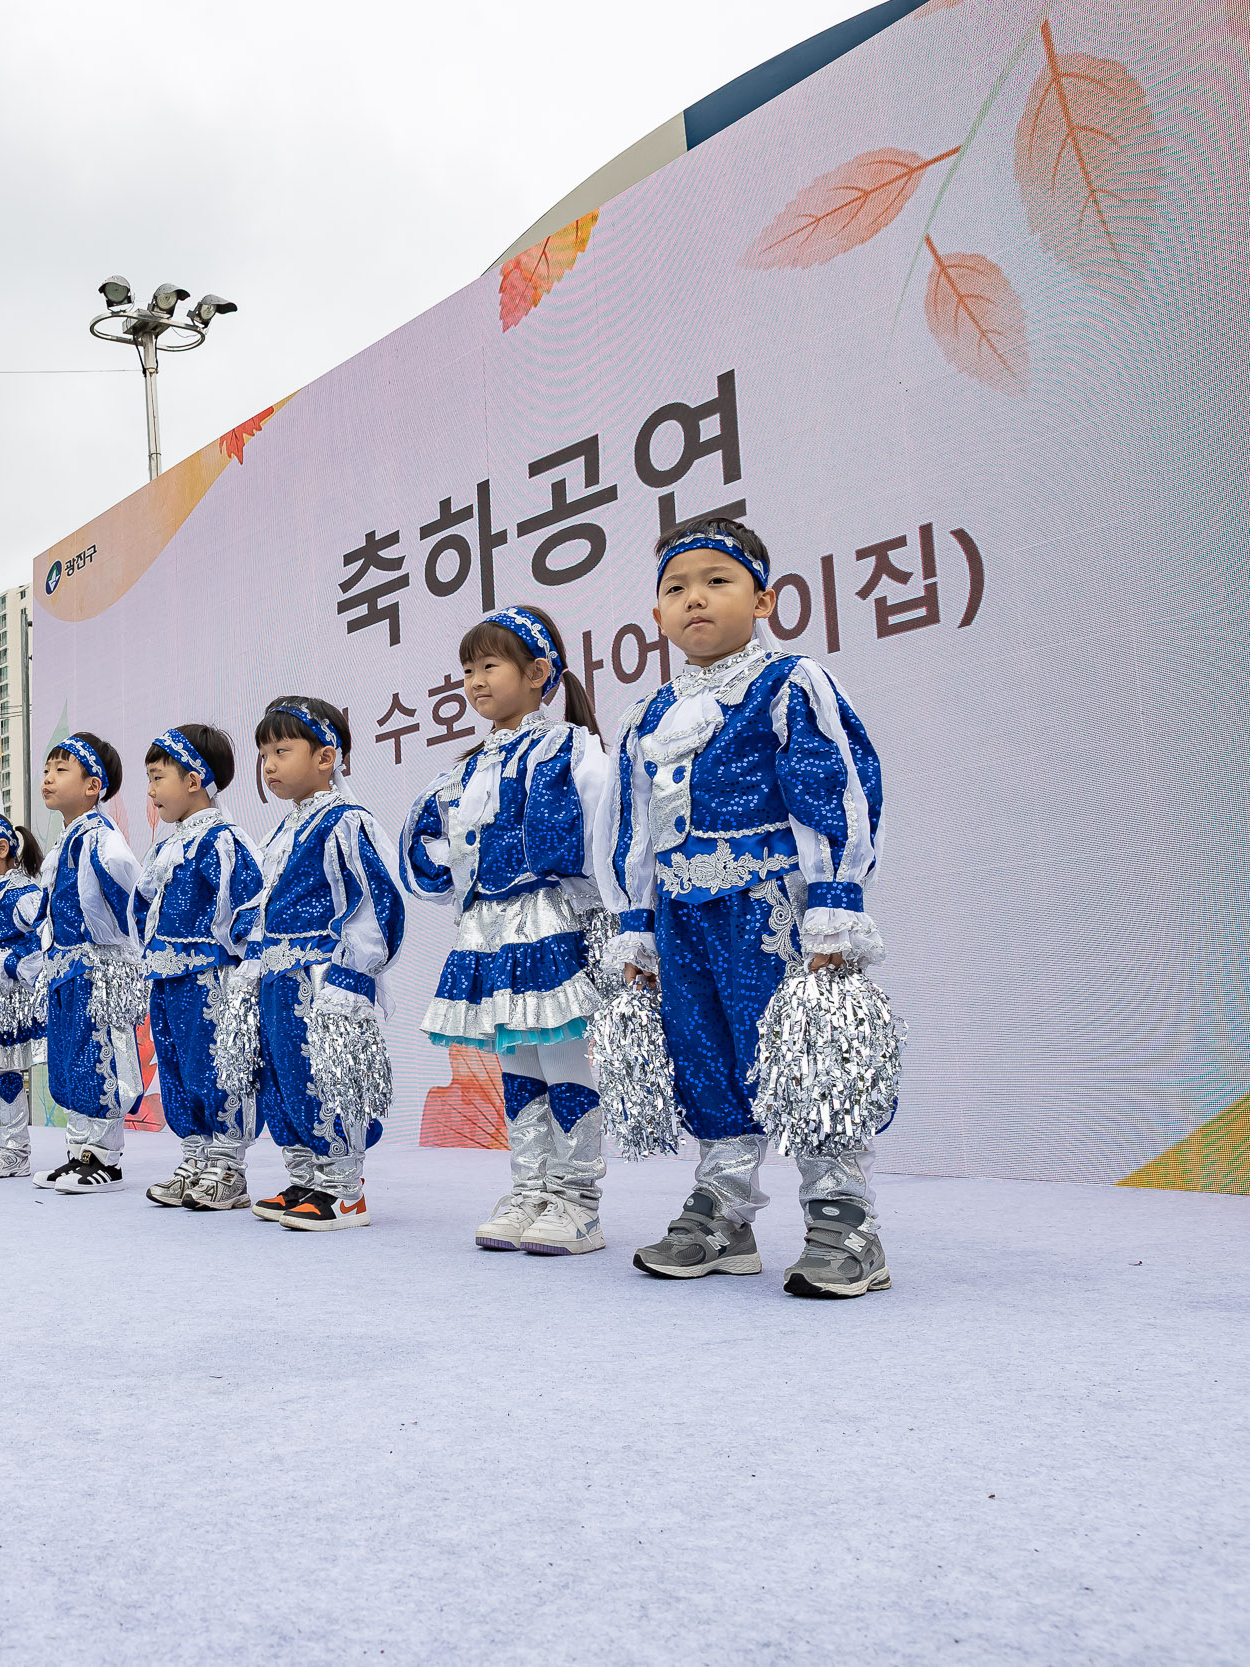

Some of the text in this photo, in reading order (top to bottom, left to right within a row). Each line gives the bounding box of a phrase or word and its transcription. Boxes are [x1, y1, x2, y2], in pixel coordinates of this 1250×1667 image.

[337, 368, 747, 647] 축하공연
[65, 544, 98, 577] 광진구
[843, 1232, 867, 1253] N
